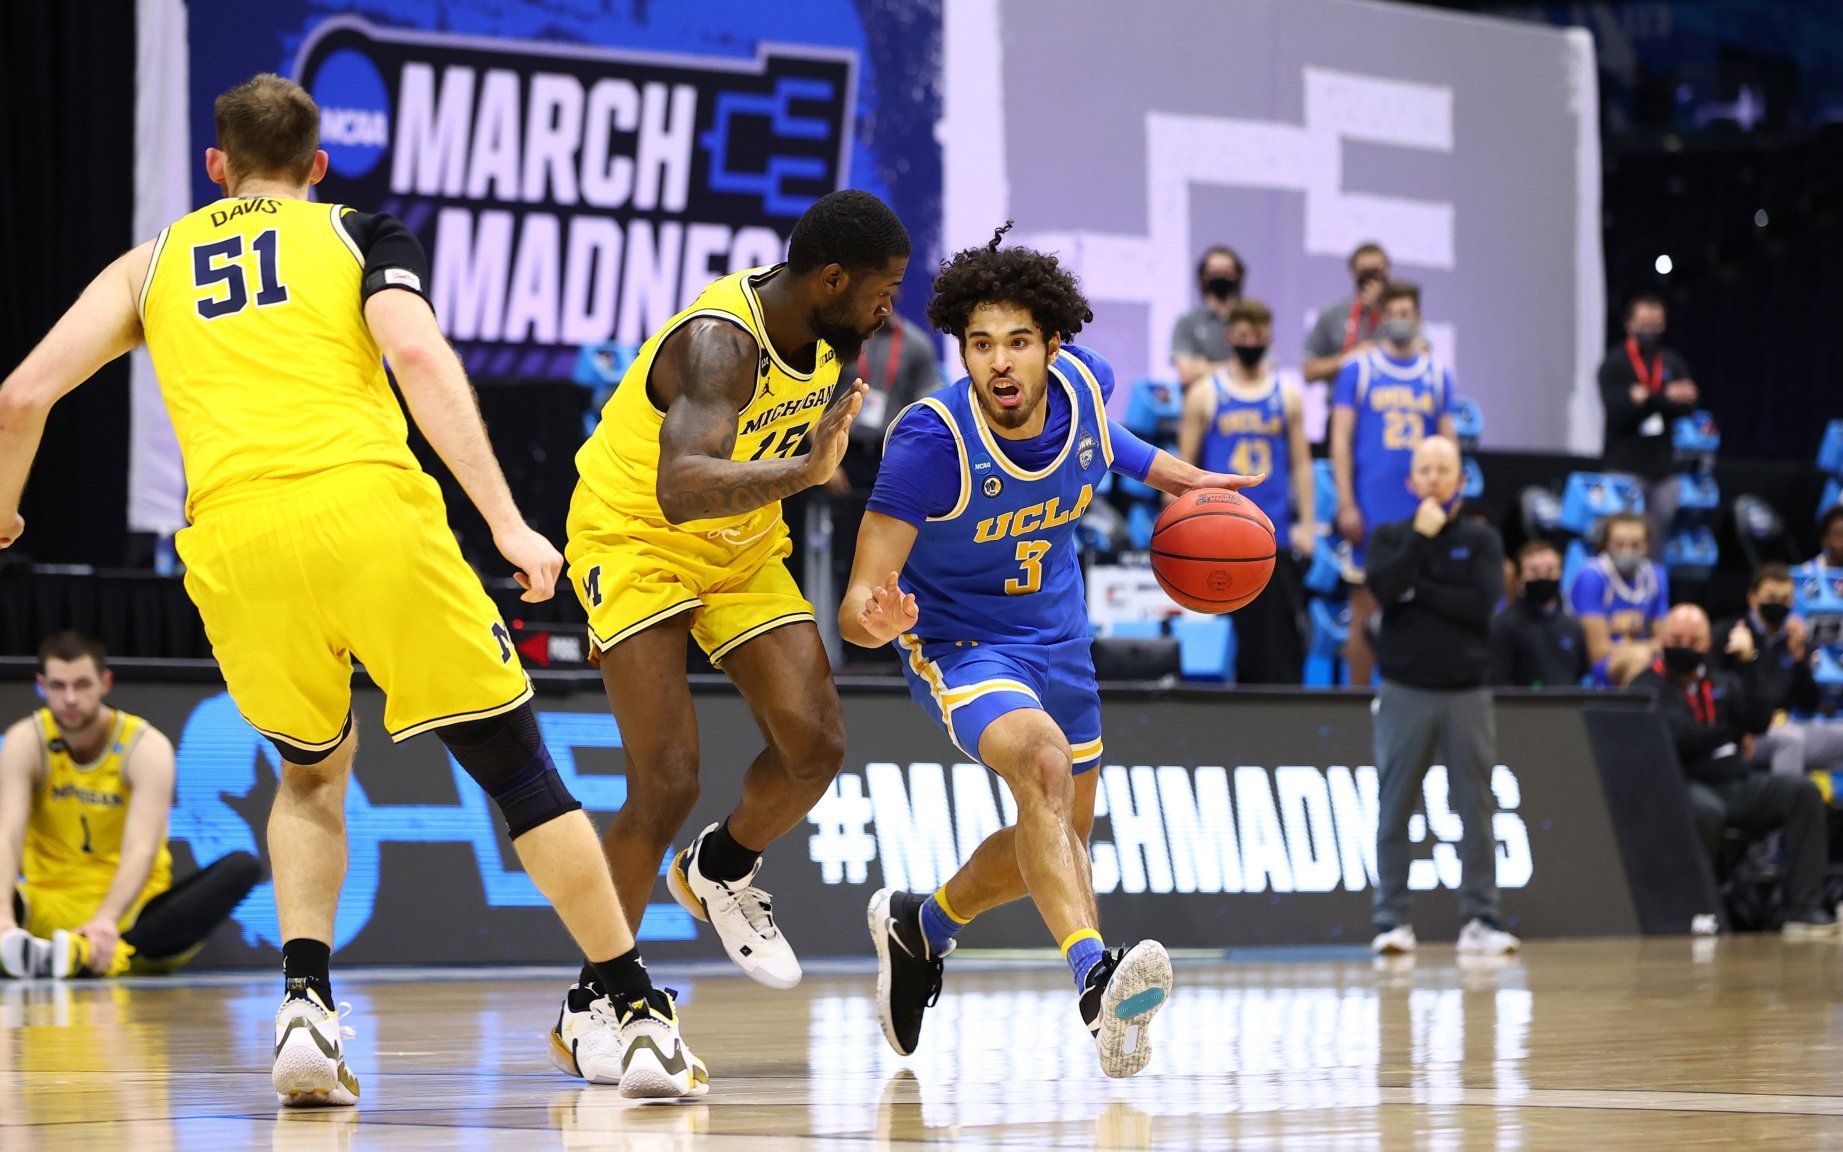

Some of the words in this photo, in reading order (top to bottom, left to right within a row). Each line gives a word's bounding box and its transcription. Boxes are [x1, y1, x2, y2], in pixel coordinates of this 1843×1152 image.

[319, 107, 389, 148] NCAA
[390, 61, 697, 213] MARCH
[210, 198, 283, 228] DAVIS
[192, 228, 289, 321] 51
[431, 206, 790, 347] MADNE
[974, 462, 992, 470] NCAA
[973, 483, 1093, 544] UCLA
[1004, 539, 1053, 596] 3
[80, 814, 93, 854] 1
